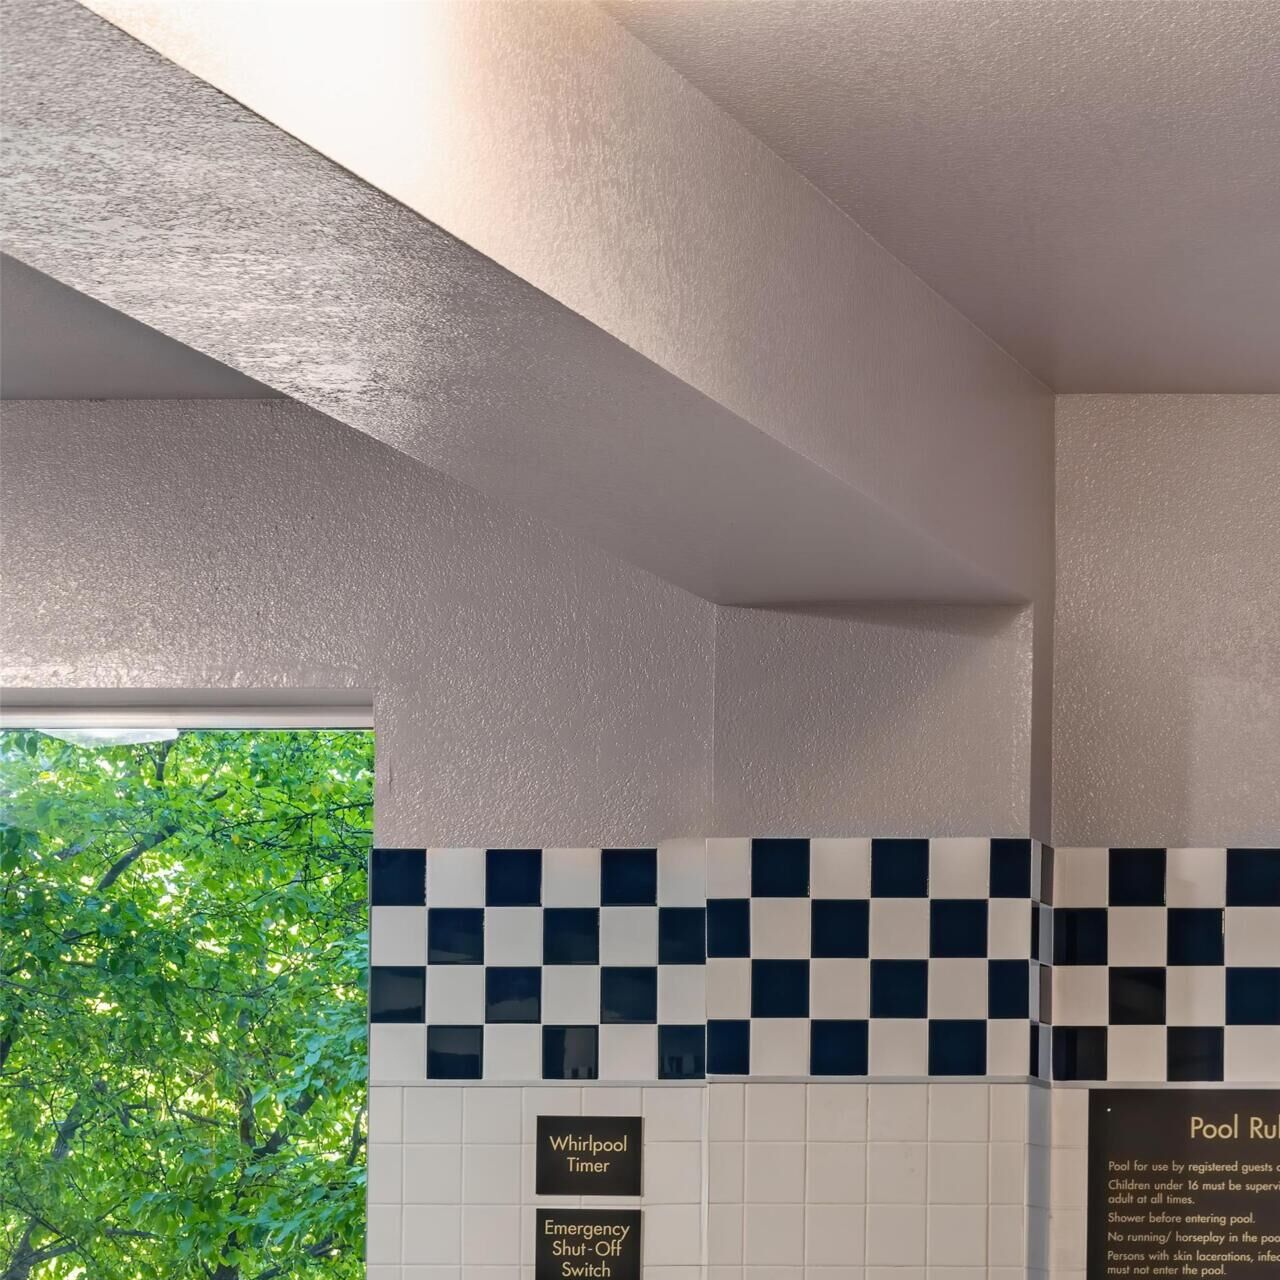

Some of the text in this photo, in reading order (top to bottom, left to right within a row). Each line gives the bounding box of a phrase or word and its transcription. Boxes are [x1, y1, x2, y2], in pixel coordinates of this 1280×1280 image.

[1190, 1114, 1238, 1138] Pool
[549, 1134, 627, 1155] Whirlpool
[566, 1157, 610, 1173] Timer
[1108, 1160, 1130, 1171] Pool
[1134, 1160, 1148, 1171] for
[1172, 1160, 1185, 1174] by
[1188, 1161, 1238, 1174] registered
[1241, 1163, 1273, 1174] guests
[1108, 1179, 1150, 1192] Children
[1154, 1179, 1184, 1192] under
[1188, 1180, 1199, 1190] 16
[1202, 1182, 1226, 1190] must
[1228, 1179, 1242, 1190] be
[1108, 1193, 1195, 1204] adult at all times.
[1108, 1212, 1255, 1226] Shower before entering pool.
[544, 1219, 630, 1241] Emergency
[1108, 1232, 1124, 1241] No
[1127, 1231, 1172, 1244] running/
[1176, 1231, 1226, 1245] horseplay
[1228, 1233, 1238, 1242] in
[1242, 1232, 1258, 1242] the
[1107, 1251, 1145, 1260] Persons
[1148, 1250, 1170, 1260] with
[1173, 1250, 1193, 1265] skin
[1196, 1250, 1254, 1265] lacerations,
[561, 1260, 611, 1278] Switch
[1107, 1264, 1226, 1277] must not enter the pool.
